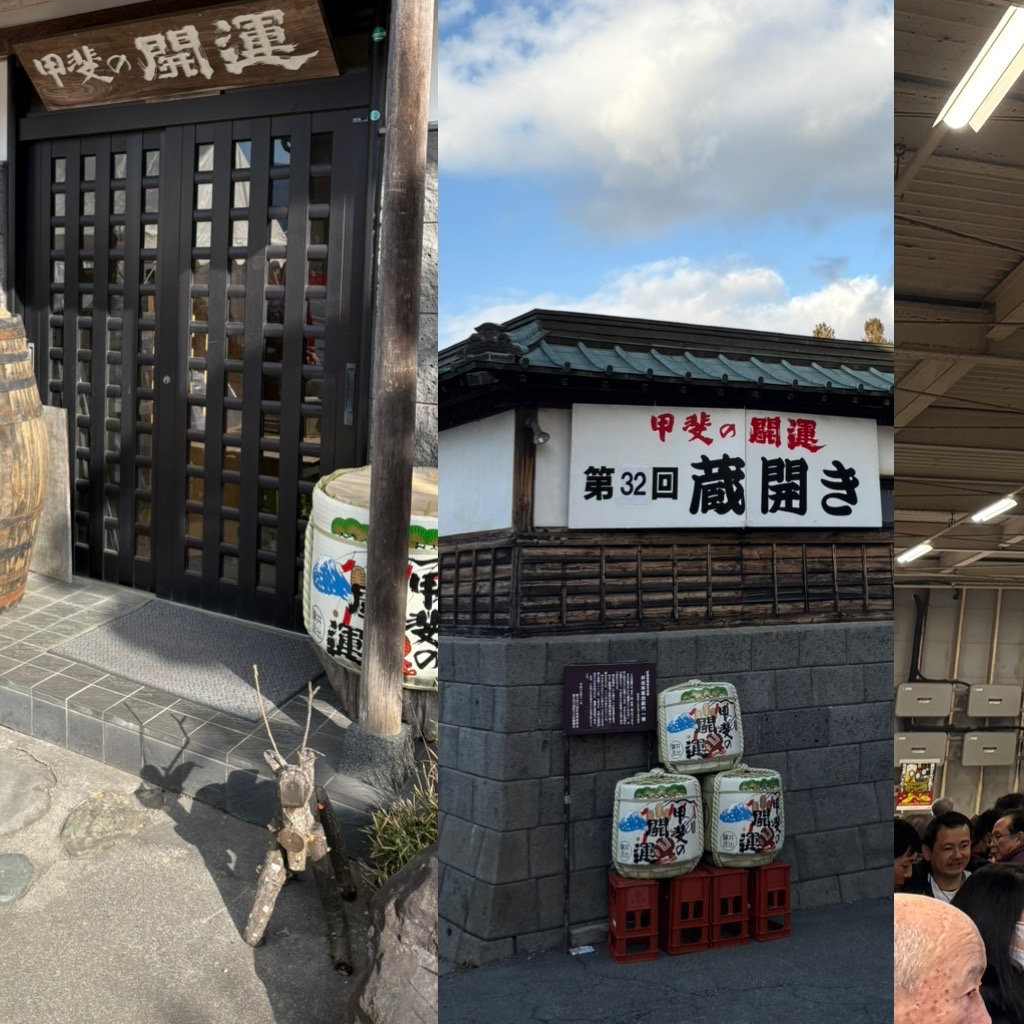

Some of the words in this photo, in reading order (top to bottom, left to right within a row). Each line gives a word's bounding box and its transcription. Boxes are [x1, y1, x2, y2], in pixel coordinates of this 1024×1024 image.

[32, 9, 319, 88] 甲斐の開運
[650, 411, 827, 453] 甲斐の開運
